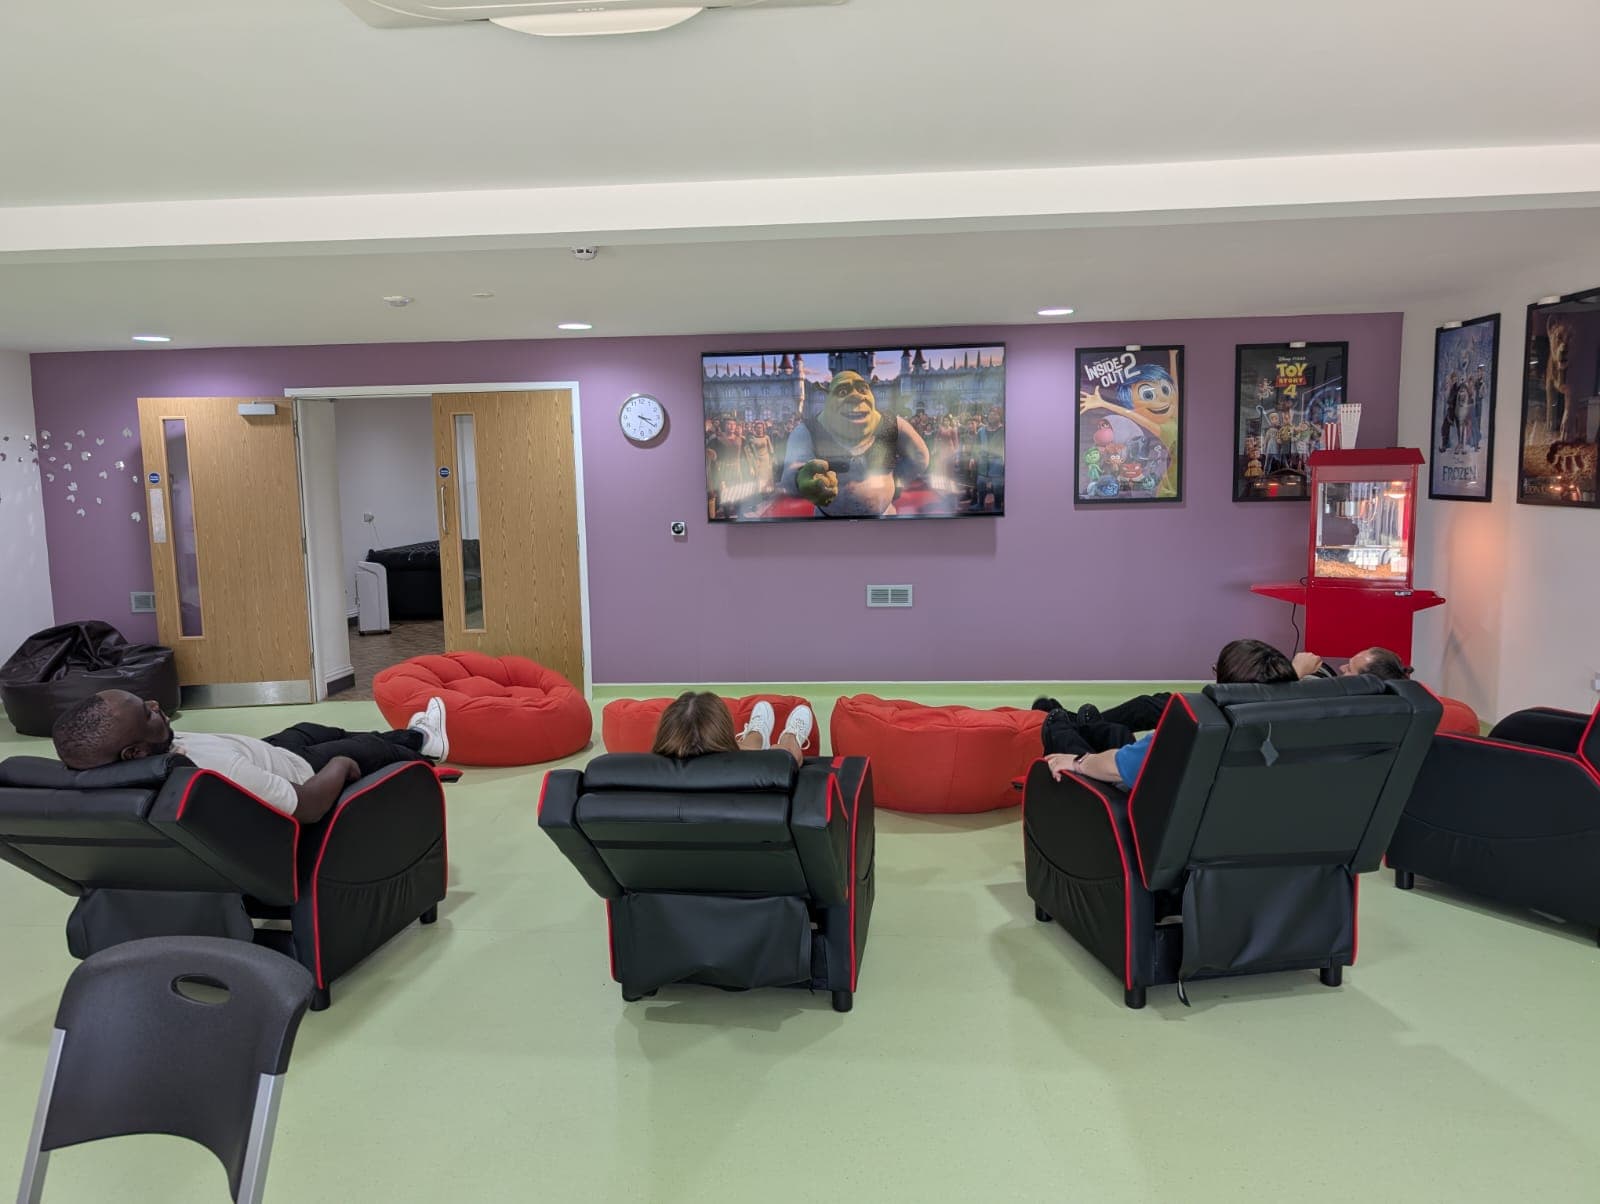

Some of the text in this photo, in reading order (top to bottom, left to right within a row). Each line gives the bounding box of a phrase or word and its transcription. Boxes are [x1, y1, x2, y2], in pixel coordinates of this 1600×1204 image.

[1084, 357, 1123, 381] INSIDE
[1120, 352, 1141, 379] 2
[1276, 363, 1308, 377] TOY
[1101, 367, 1124, 388] OUT
[1283, 385, 1297, 399] 4
[1442, 465, 1478, 481] FROZEN
